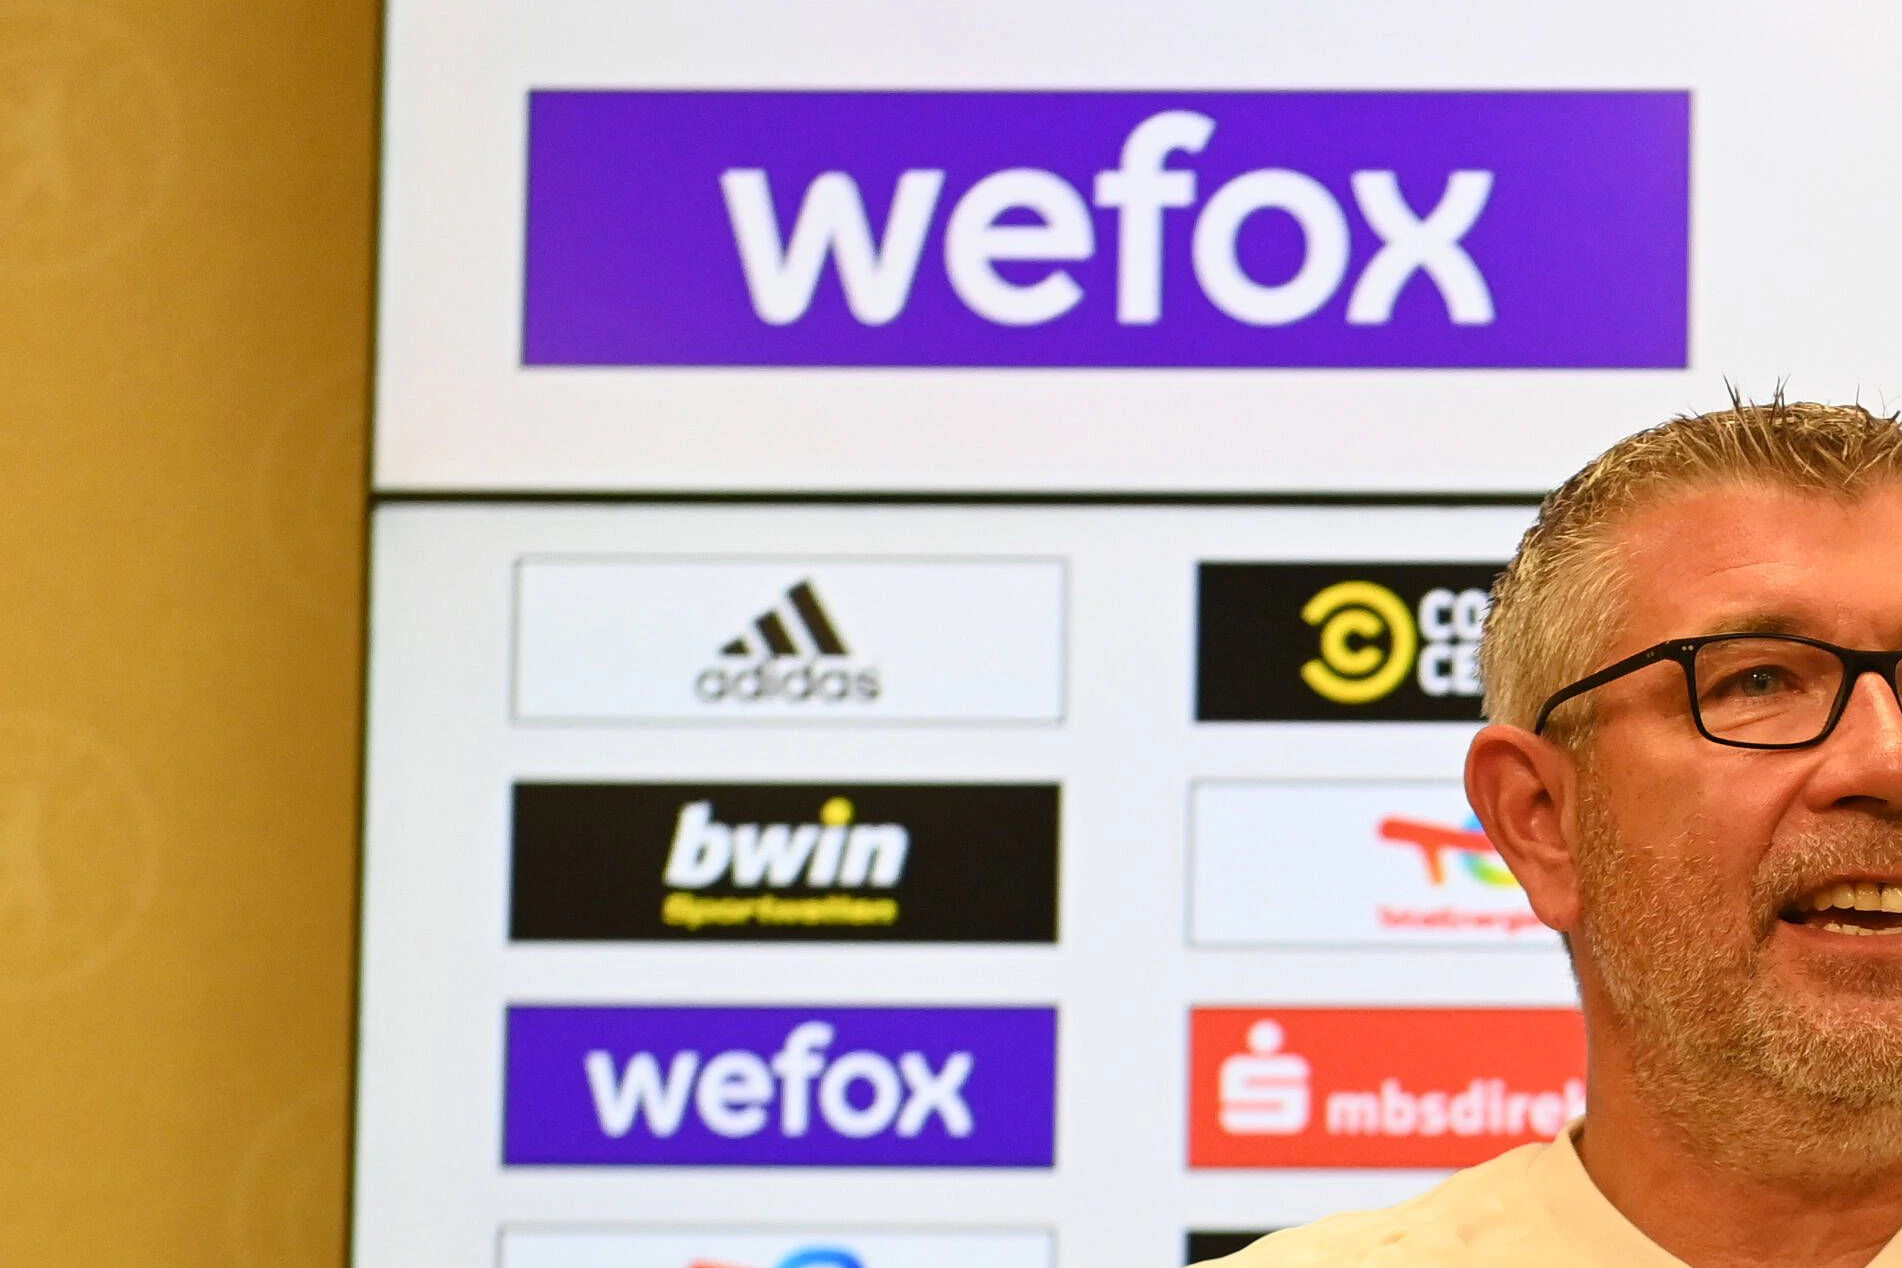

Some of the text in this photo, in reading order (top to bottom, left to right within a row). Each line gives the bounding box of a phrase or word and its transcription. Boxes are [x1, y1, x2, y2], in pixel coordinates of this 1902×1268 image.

[721, 110, 1495, 326] wefox
[695, 659, 881, 702] adidas
[663, 798, 909, 888] bwin
[584, 1021, 973, 1138] wefox
[1325, 1077, 1586, 1136] mbsdirek
